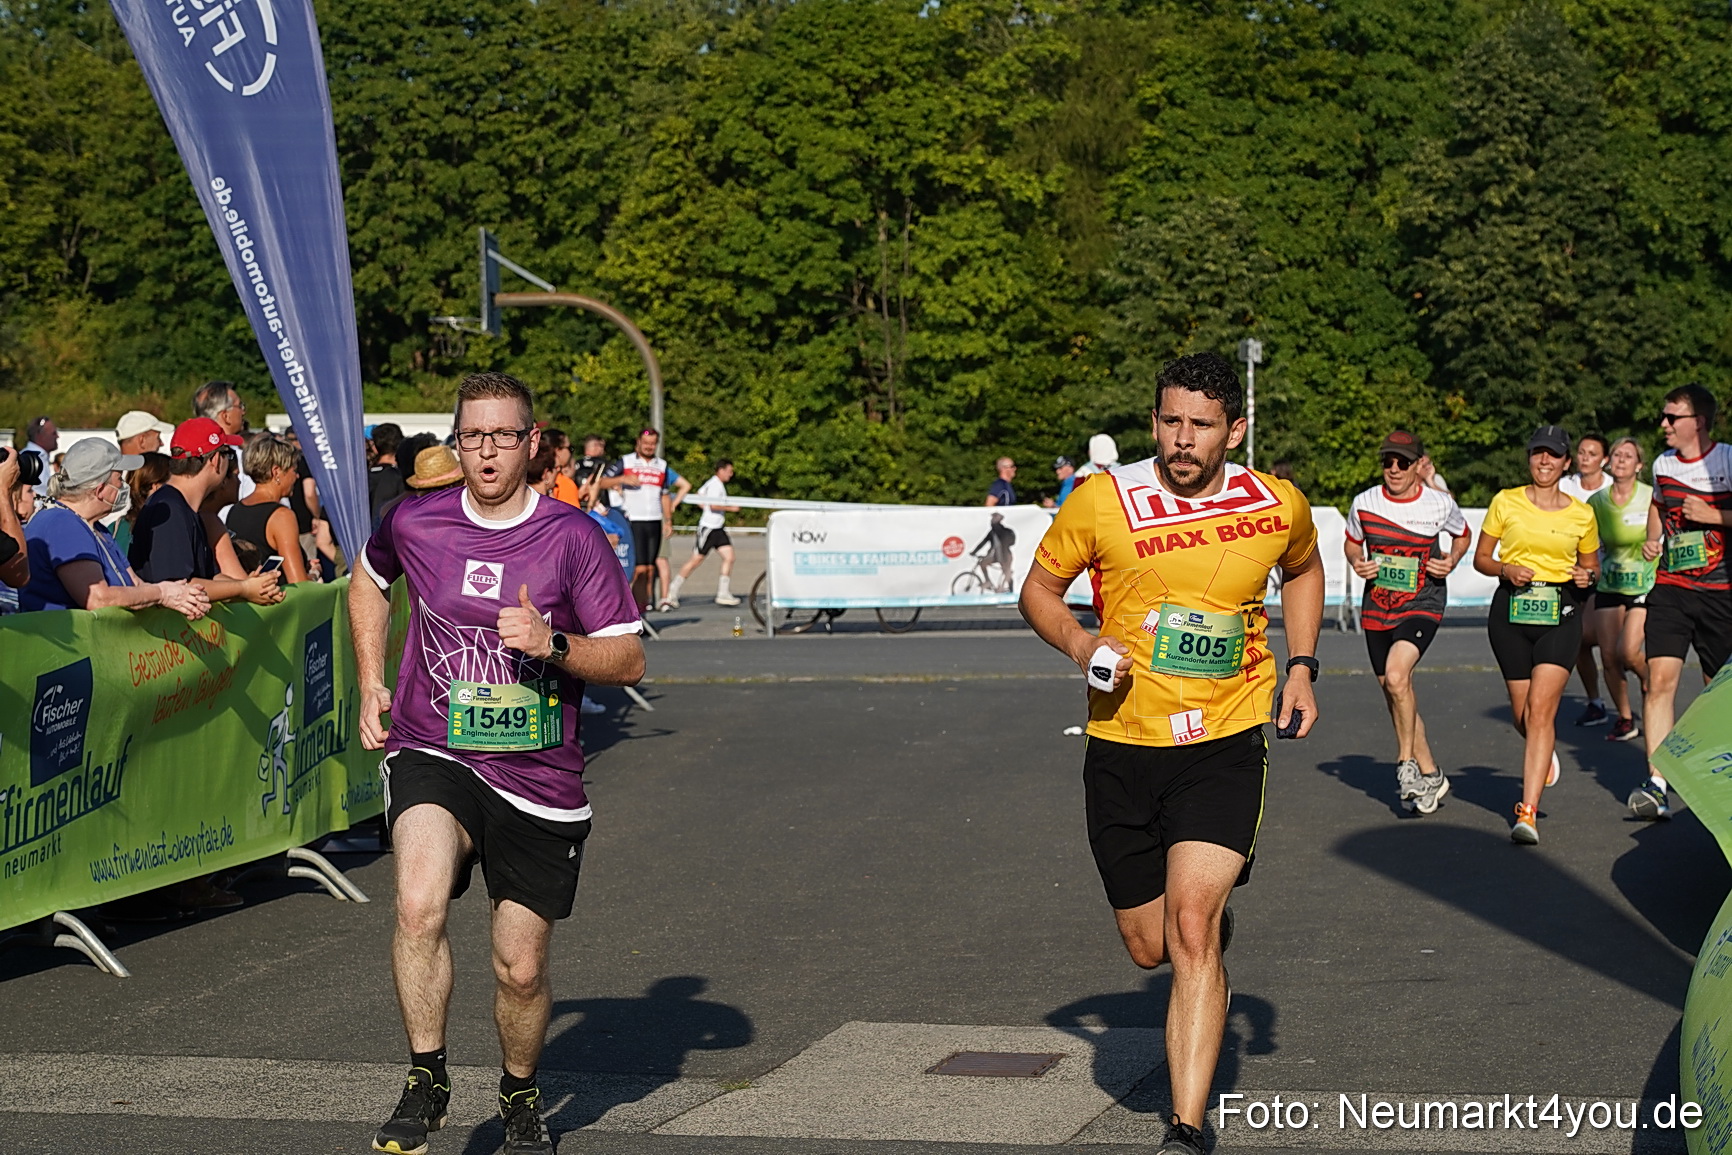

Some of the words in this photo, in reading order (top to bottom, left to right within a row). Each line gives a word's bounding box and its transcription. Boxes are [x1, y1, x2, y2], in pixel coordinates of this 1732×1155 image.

[792, 531, 827, 543] NOW
[1134, 529, 1210, 559] MAX
[1215, 516, 1290, 543] BÖGL
[1675, 545, 1695, 559] 126
[467, 574, 498, 585] FUCHS
[1382, 566, 1406, 580] 165
[1522, 599, 1548, 612] 559
[128, 629, 185, 688] Gesunde
[180, 621, 228, 661] Firmen
[1158, 635, 1170, 660] RUN
[1179, 632, 1228, 658] 805
[1231, 637, 1242, 668] 2022
[1166, 652, 1208, 664] Kurzendorfer
[42, 698, 84, 727] Fischer
[453, 712, 462, 736] RUN
[464, 706, 528, 730] 1549
[529, 708, 538, 740] 2022
[46, 716, 78, 736] AUTOMOBILE
[461, 729, 498, 739] Englmeier
[499, 730, 530, 738] Andreas
[3, 734, 133, 850] firmenlauf
[5, 832, 62, 880] neumarkt
[89, 815, 235, 884] www.firmenlauf-oberpfalz.de
